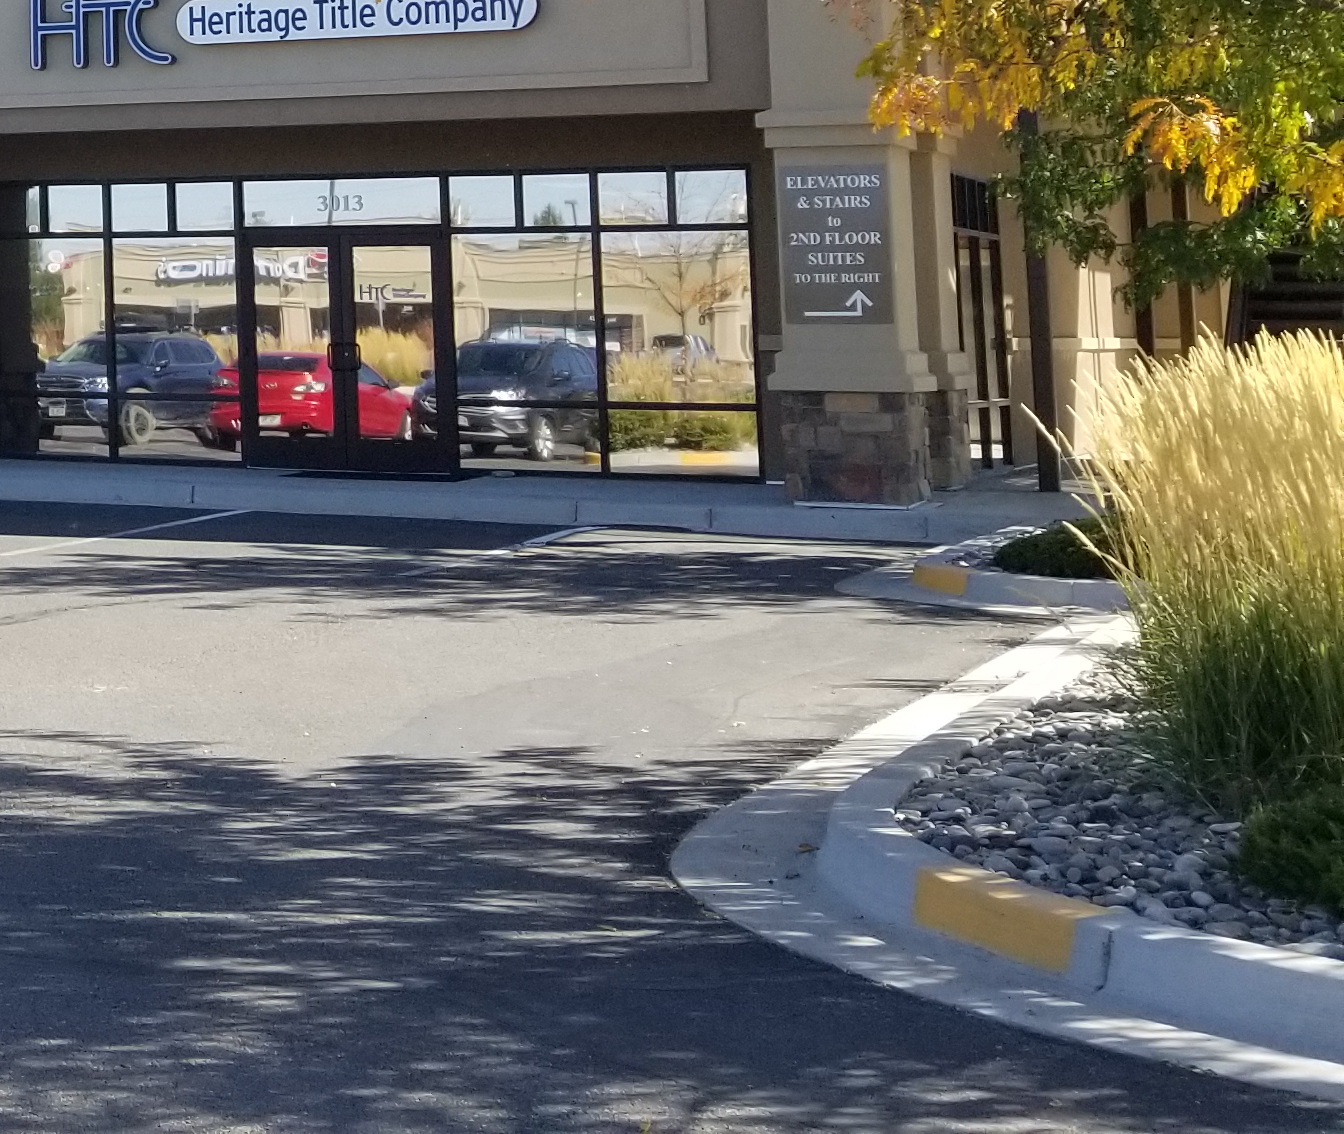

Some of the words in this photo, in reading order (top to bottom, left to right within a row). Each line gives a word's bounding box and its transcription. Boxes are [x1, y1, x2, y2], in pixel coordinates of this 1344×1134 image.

[188, 2, 308, 40] Heritage
[786, 174, 880, 189] ELEVATORS
[316, 194, 364, 212] 3013
[797, 196, 810, 209] &
[814, 195, 871, 209] STAIRS
[827, 215, 842, 227] to
[789, 232, 821, 246] 2ND
[825, 231, 882, 245] FLOOR
[808, 252, 865, 265] SUITES
[794, 273, 811, 284] TO
[814, 273, 838, 284] THE
[841, 272, 881, 284] RIGHT
[359, 283, 391, 300] HTC
